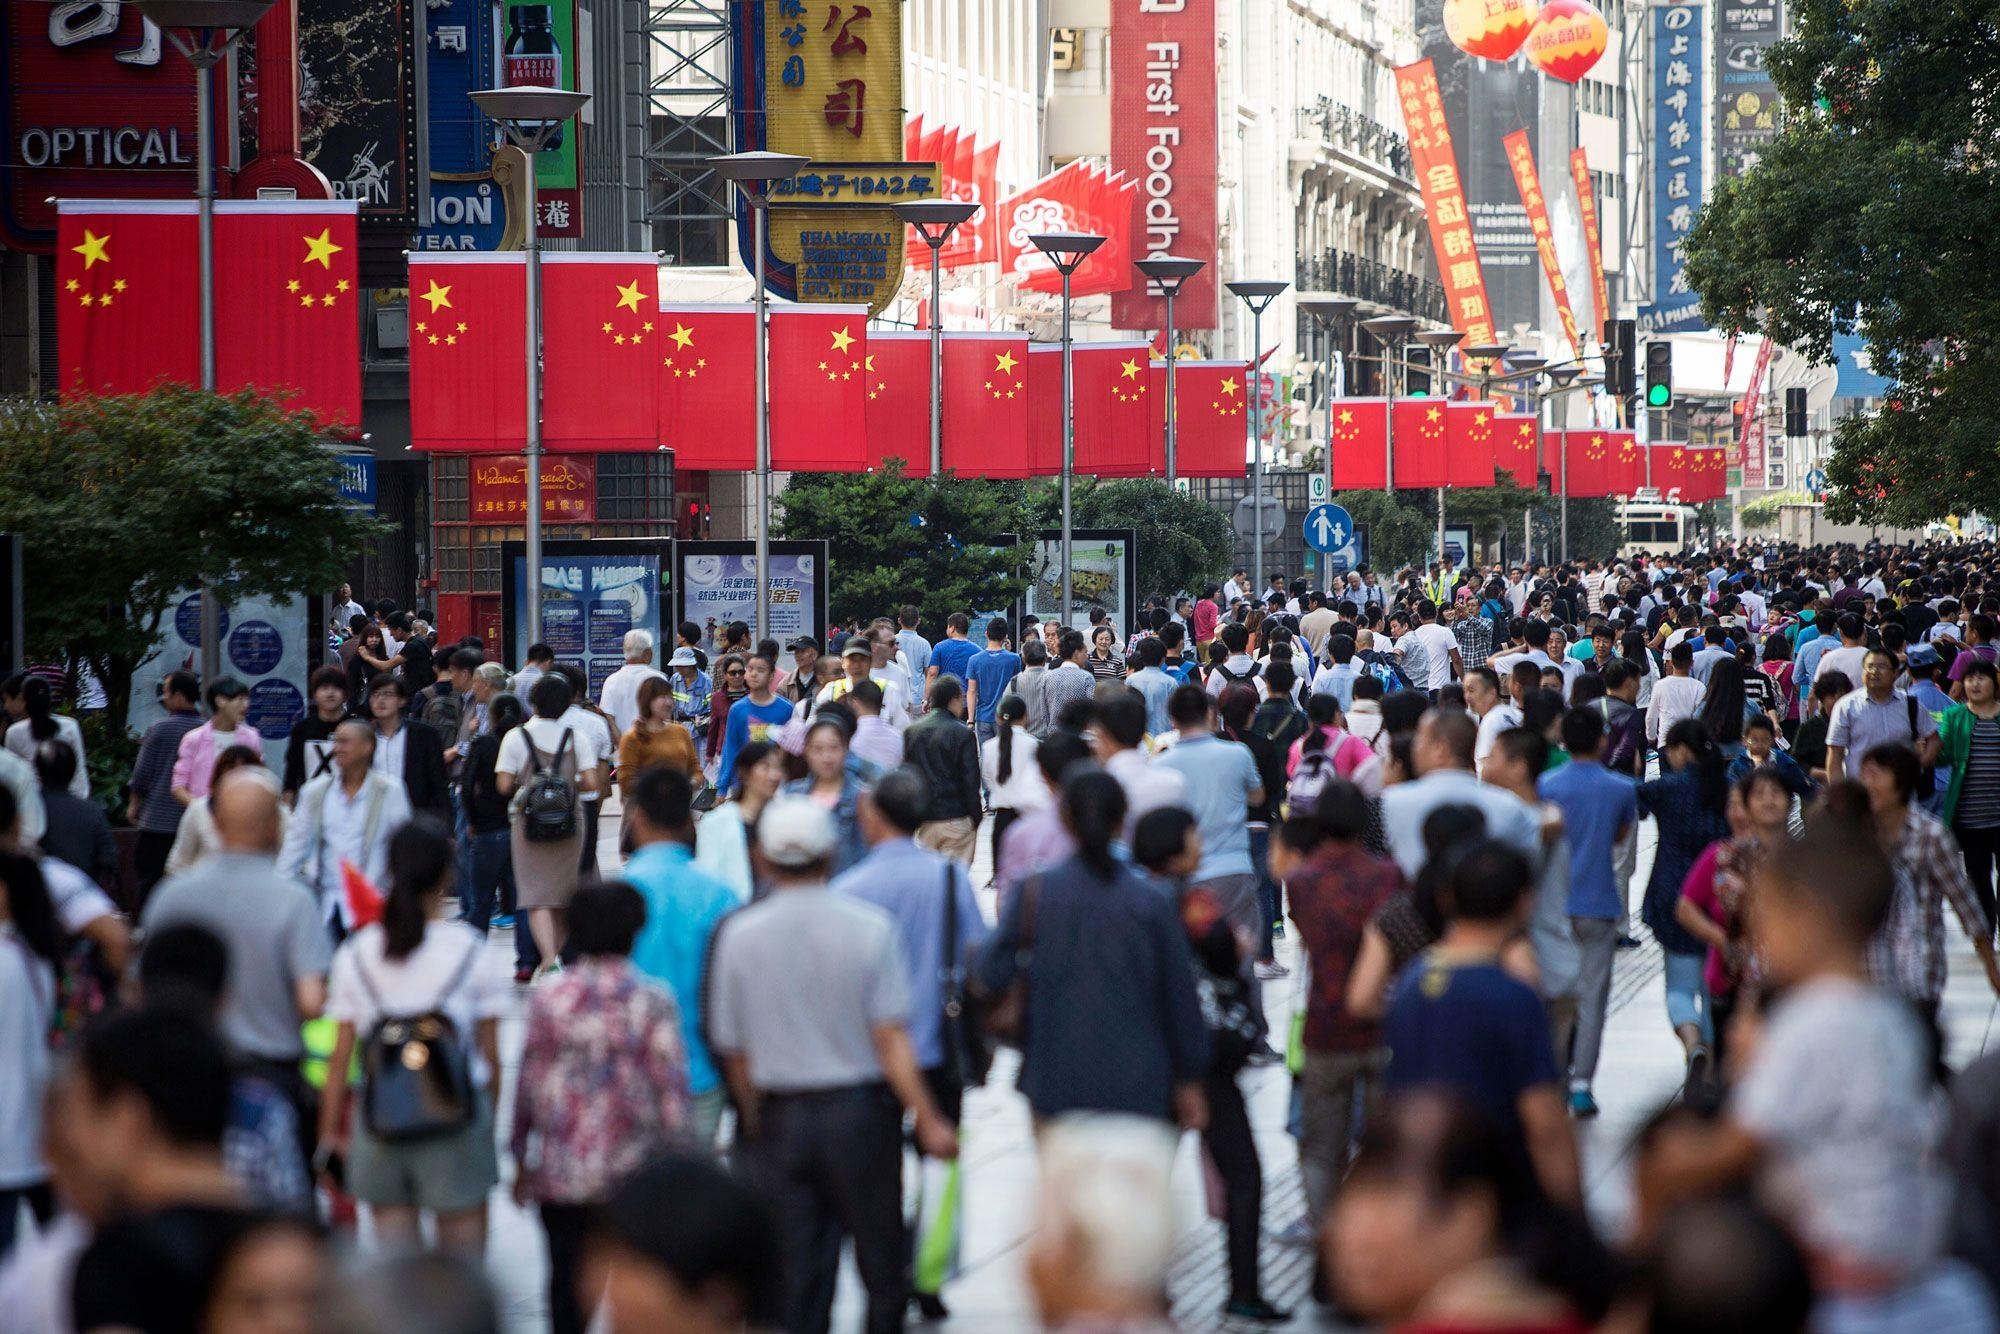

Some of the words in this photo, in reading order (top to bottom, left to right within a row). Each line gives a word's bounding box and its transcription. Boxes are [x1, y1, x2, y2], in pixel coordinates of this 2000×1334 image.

[822, 4, 872, 139] 公司
[1145, 42, 1180, 117] First
[21, 127, 192, 166] OPTICAL
[1145, 127, 1181, 296] Foodhll
[800, 231, 892, 246] SHANGHAI
[803, 248, 888, 263] BEDROOM
[804, 264, 887, 280] ARTICLES
[476, 466, 520, 487] Madame
[516, 464, 579, 491] Tsauds
[476, 500, 585, 512] 上海杜莎夫蜡像馆
[722, 577, 794, 589] 现金管帮手
[697, 588, 801, 604] 就选兴业银行金宝
